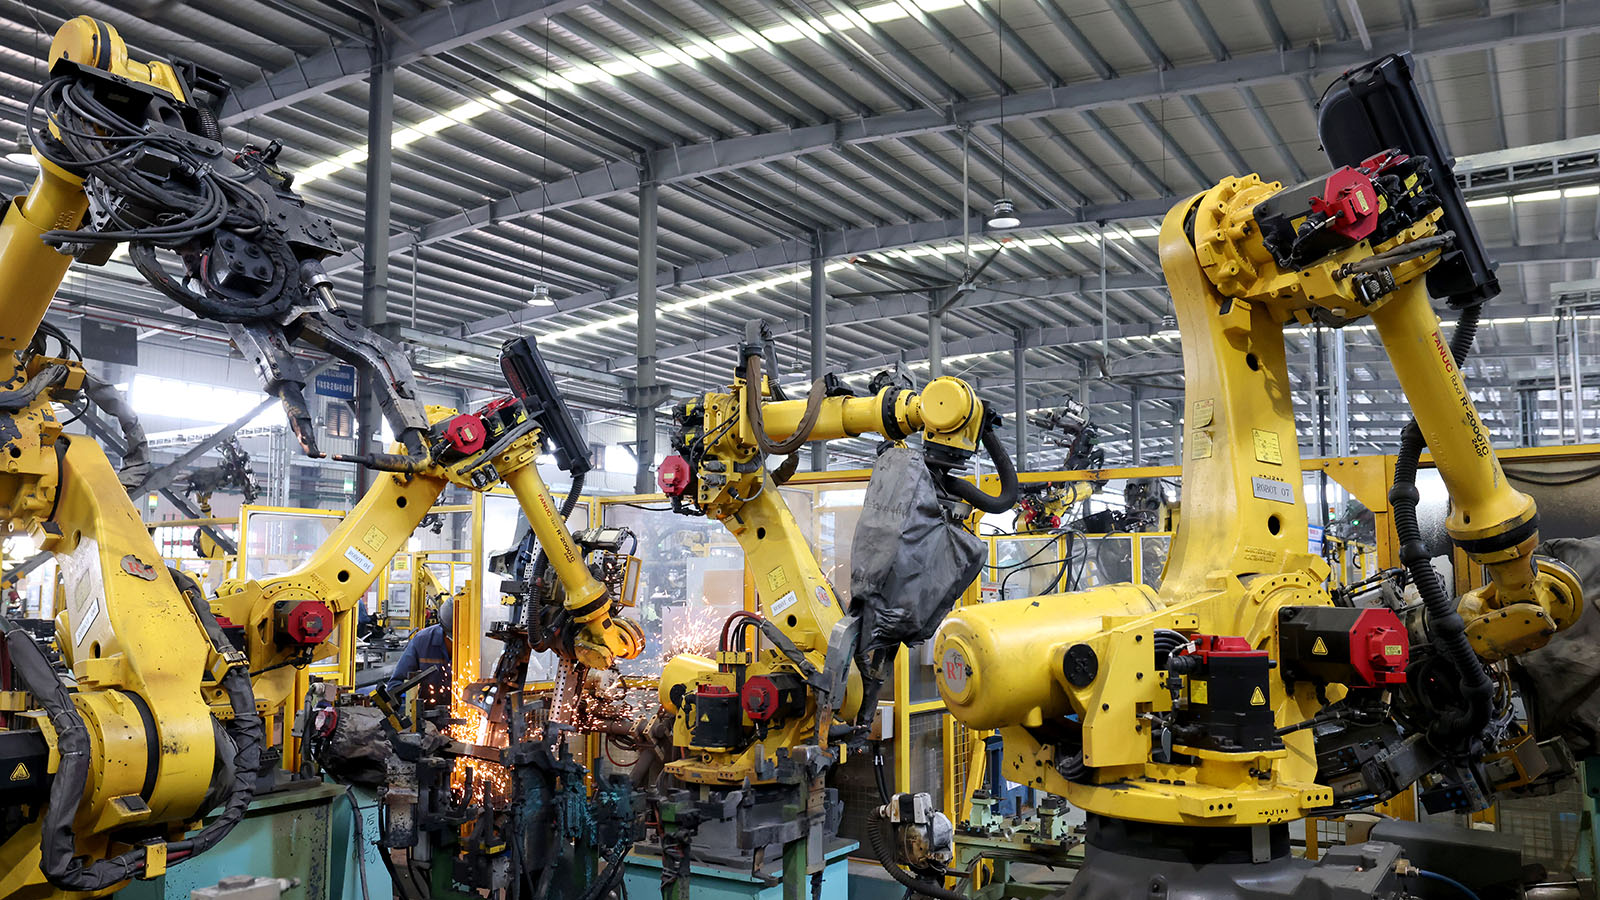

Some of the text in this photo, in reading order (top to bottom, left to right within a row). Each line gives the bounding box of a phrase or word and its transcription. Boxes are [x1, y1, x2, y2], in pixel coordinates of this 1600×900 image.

[1432, 331, 1453, 373] FANUC
[1450, 374, 1462, 395] Robot
[1256, 482, 1290, 497] ROBOT 07
[537, 493, 553, 517] FANUC
[946, 661, 963, 681] R7
